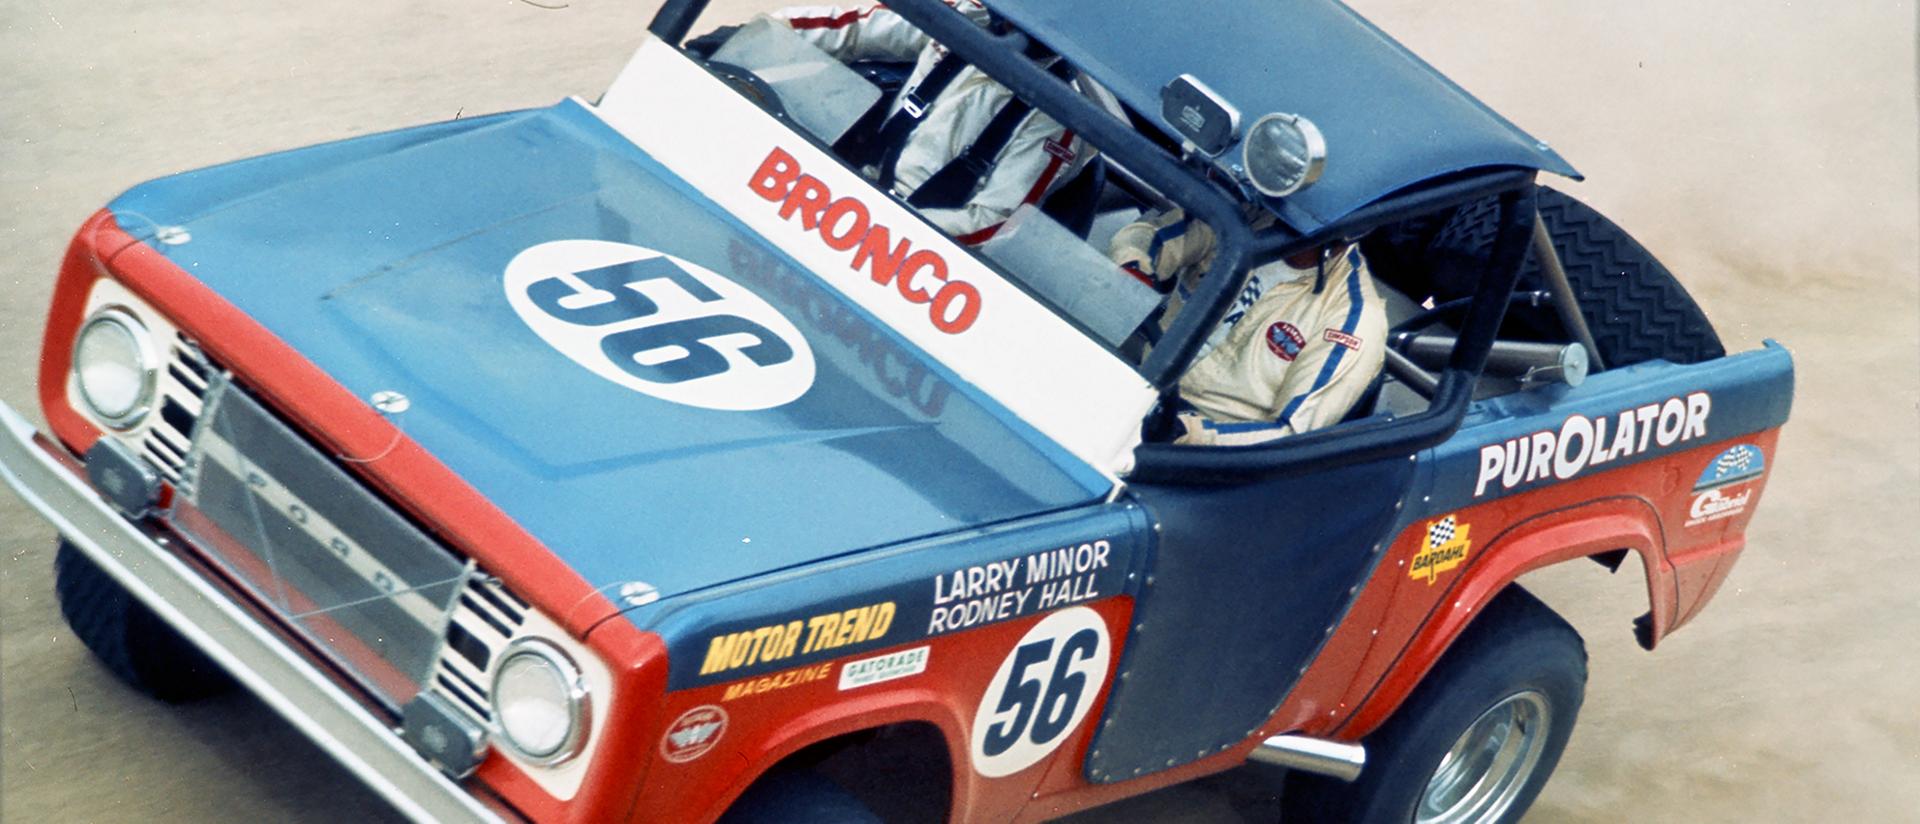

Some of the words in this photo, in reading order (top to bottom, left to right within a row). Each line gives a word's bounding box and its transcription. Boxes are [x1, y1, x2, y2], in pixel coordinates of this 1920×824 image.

[747, 146, 982, 335] BRONCO
[526, 256, 794, 384] 56
[1474, 392, 1711, 497] PUROLATOR
[934, 558, 1020, 605] LARRY
[1026, 540, 1110, 585] MINOR
[1412, 545, 1465, 571] BARDAHL
[699, 620, 804, 676] MOTOR
[802, 601, 896, 654] TREND
[928, 587, 1033, 635] RODNEY
[1039, 573, 1098, 610] HALL
[721, 663, 834, 702] MAGAZINE
[847, 650, 925, 677] GATORADE
[983, 628, 1099, 757] 56
